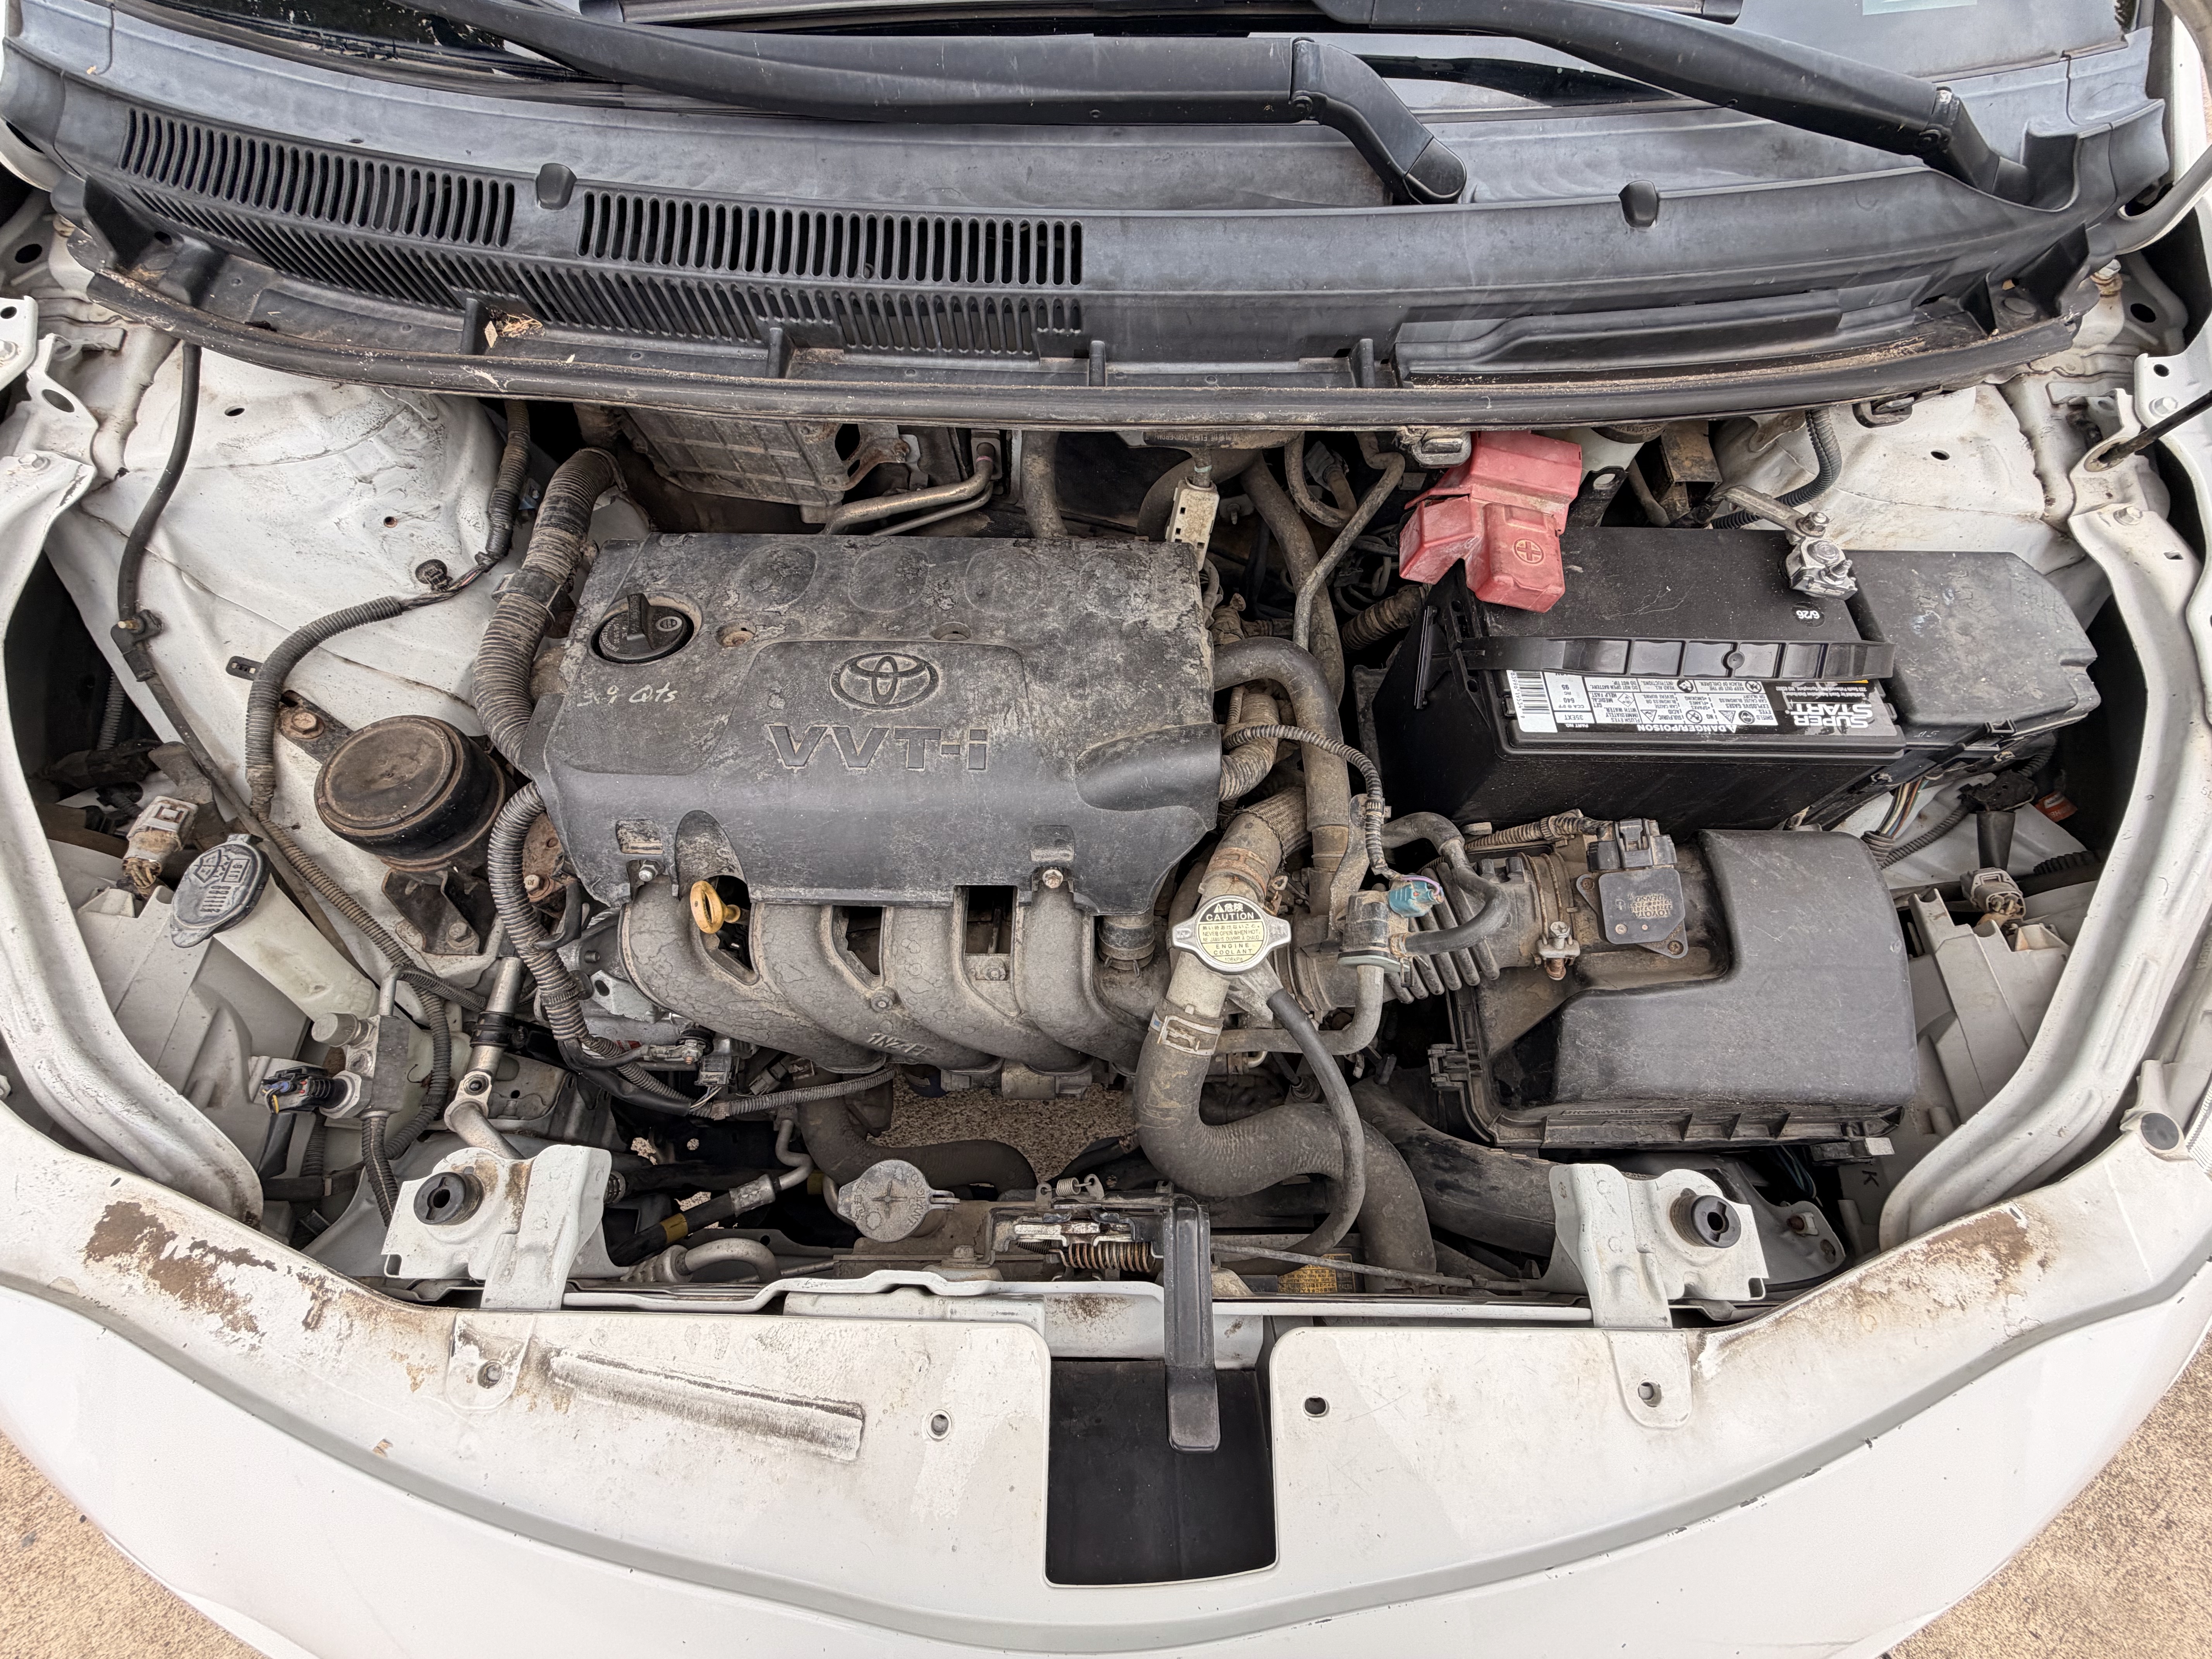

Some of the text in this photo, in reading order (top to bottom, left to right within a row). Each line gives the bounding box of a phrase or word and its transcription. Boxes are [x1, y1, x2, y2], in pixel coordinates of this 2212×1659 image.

[1796, 610, 1820, 619] 6/26
[1793, 716, 1869, 728] SUPER
[765, 725, 988, 771] VVT-i
[1224, 903, 1243, 912] 危険
[1206, 912, 1254, 921] CAUTION
[1633, 910, 1670, 918] TOYOTA
